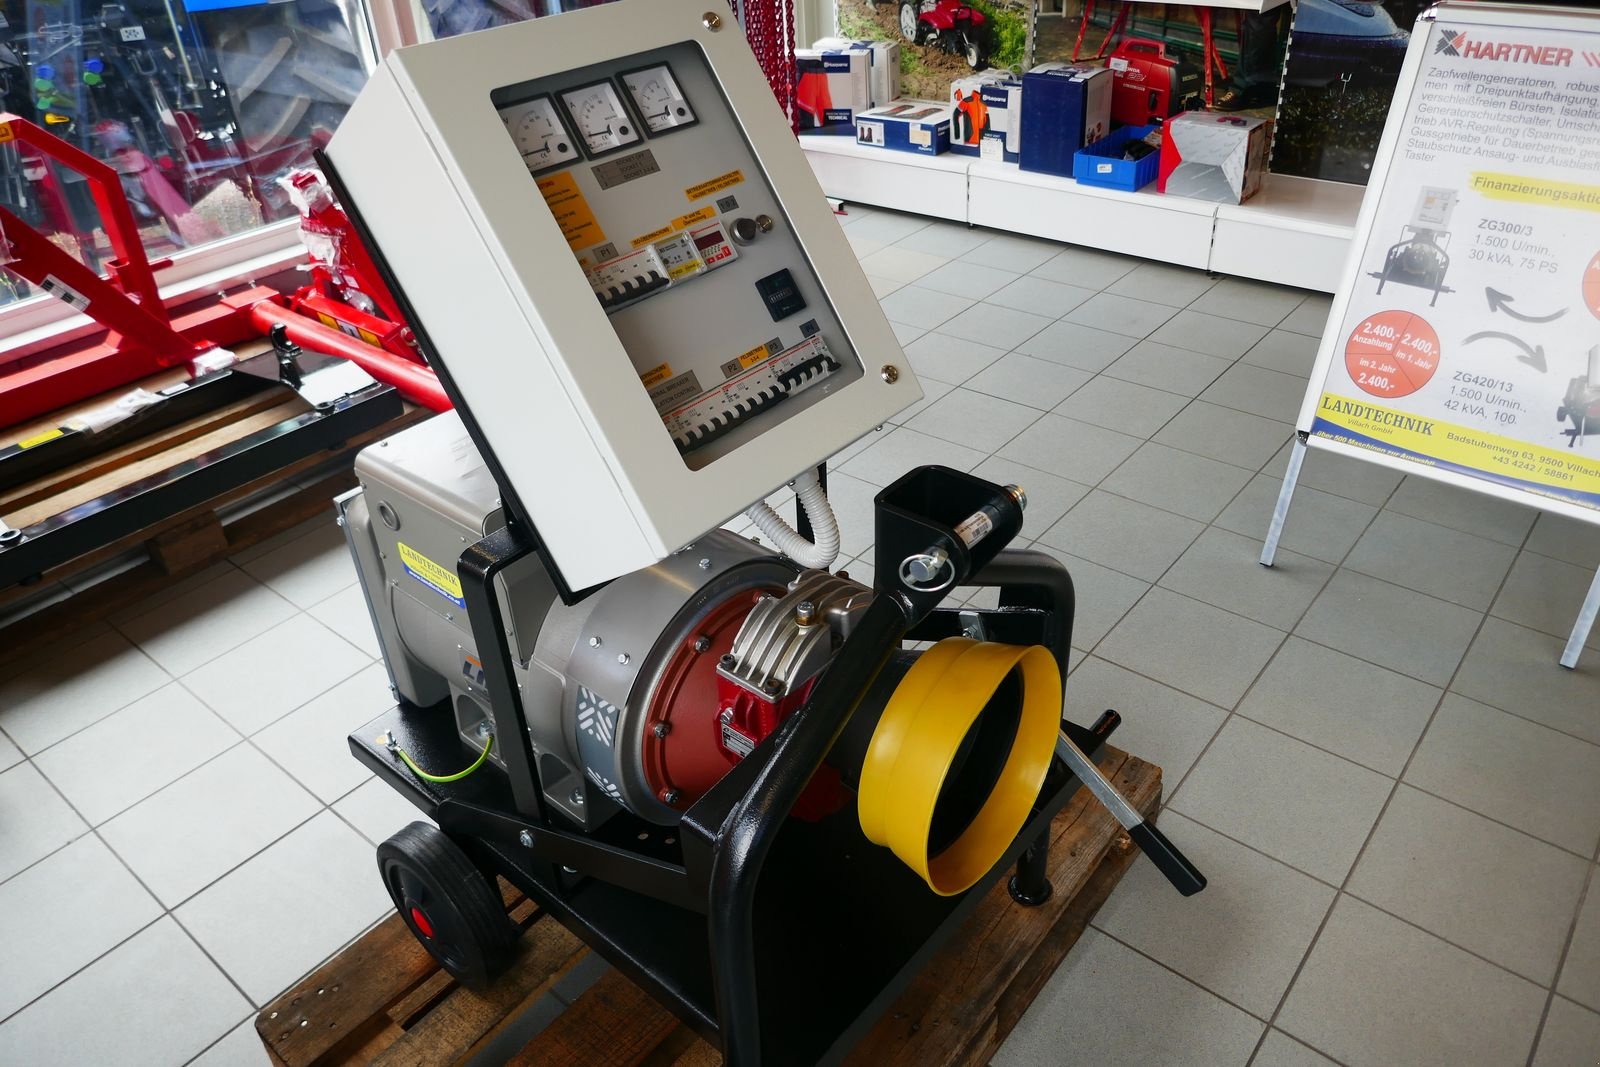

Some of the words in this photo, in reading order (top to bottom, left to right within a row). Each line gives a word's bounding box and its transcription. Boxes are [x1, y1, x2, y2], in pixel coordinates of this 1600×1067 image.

[1463, 40, 1574, 68] HARTNER
[1425, 80, 1447, 90] men
[1454, 83, 1471, 93] mit
[1421, 93, 1506, 109] verschleißfreien
[1414, 115, 1437, 126] trieb
[1439, 118, 1519, 137] AVR-Regelung
[1557, 119, 1600, 134] Umsch
[1411, 126, 1480, 144] Gussgetriebe
[1484, 135, 1499, 146] für
[1502, 137, 1576, 156] Dauerbetrieb
[1405, 149, 1436, 162] Taster
[1407, 138, 1472, 155] Staubschutz
[1475, 146, 1520, 162] Ansaug-
[1523, 153, 1544, 164] und
[1478, 218, 1534, 237] ZG300/3
[1475, 234, 1509, 249] 1.500
[600, 248, 611, 257] P1
[1468, 248, 1485, 261] 30
[1520, 257, 1536, 270] 75
[1538, 260, 1559, 274] PS
[769, 342, 778, 351] P3
[1352, 334, 1393, 351] Anzahlung
[1363, 322, 1401, 341] 2.400,-
[1401, 333, 1438, 356] 2.400,-
[727, 363, 738, 371] P2
[1359, 358, 1370, 367] im
[1370, 360, 1377, 369] 2.
[1378, 363, 1397, 374] Jahr
[1395, 350, 1406, 359] im
[1407, 354, 1413, 362] 1.
[1414, 357, 1433, 370] Jahr
[1357, 372, 1395, 391] 2.400,-
[1453, 371, 1514, 393] ZG420/13
[1450, 386, 1482, 401] 1.500
[1444, 399, 1460, 411] 42
[1322, 397, 1435, 436] LANDTECHNIK
[1347, 418, 1370, 430] Villach
[1371, 425, 1394, 435] GmbH
[1334, 434, 1348, 443] 500
[1348, 438, 1388, 453] Maschinen
[1387, 449, 1401, 457] zur
[1446, 431, 1519, 458] Badstubenweg
[1539, 455, 1564, 468] 9500
[1567, 462, 1600, 478] Villach
[1493, 455, 1510, 465] +43
[1511, 459, 1537, 472] 4242
[1544, 467, 1575, 482] 58861
[401, 545, 458, 586] LANDTECHNIK
